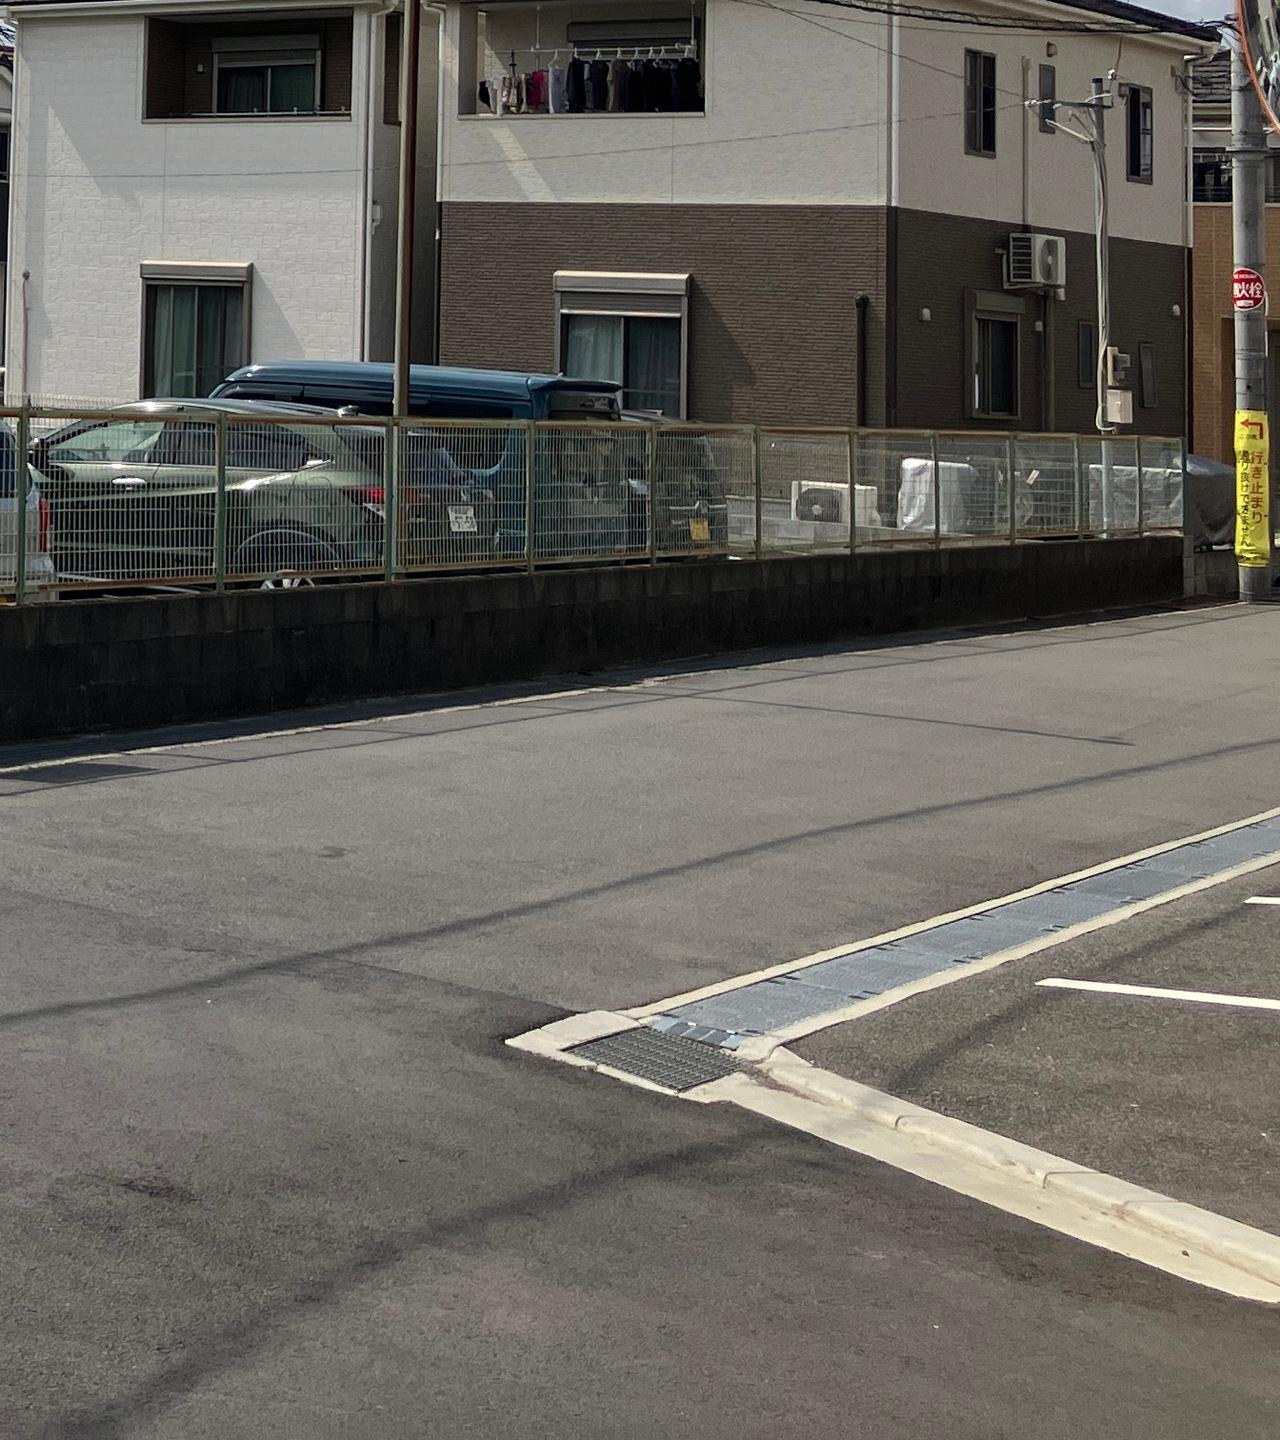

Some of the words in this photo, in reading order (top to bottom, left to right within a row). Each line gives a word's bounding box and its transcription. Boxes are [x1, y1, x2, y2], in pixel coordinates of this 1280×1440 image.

[1240, 450, 1250, 546] 通り抜けできません
[1250, 451, 1264, 524] 行き止まり
